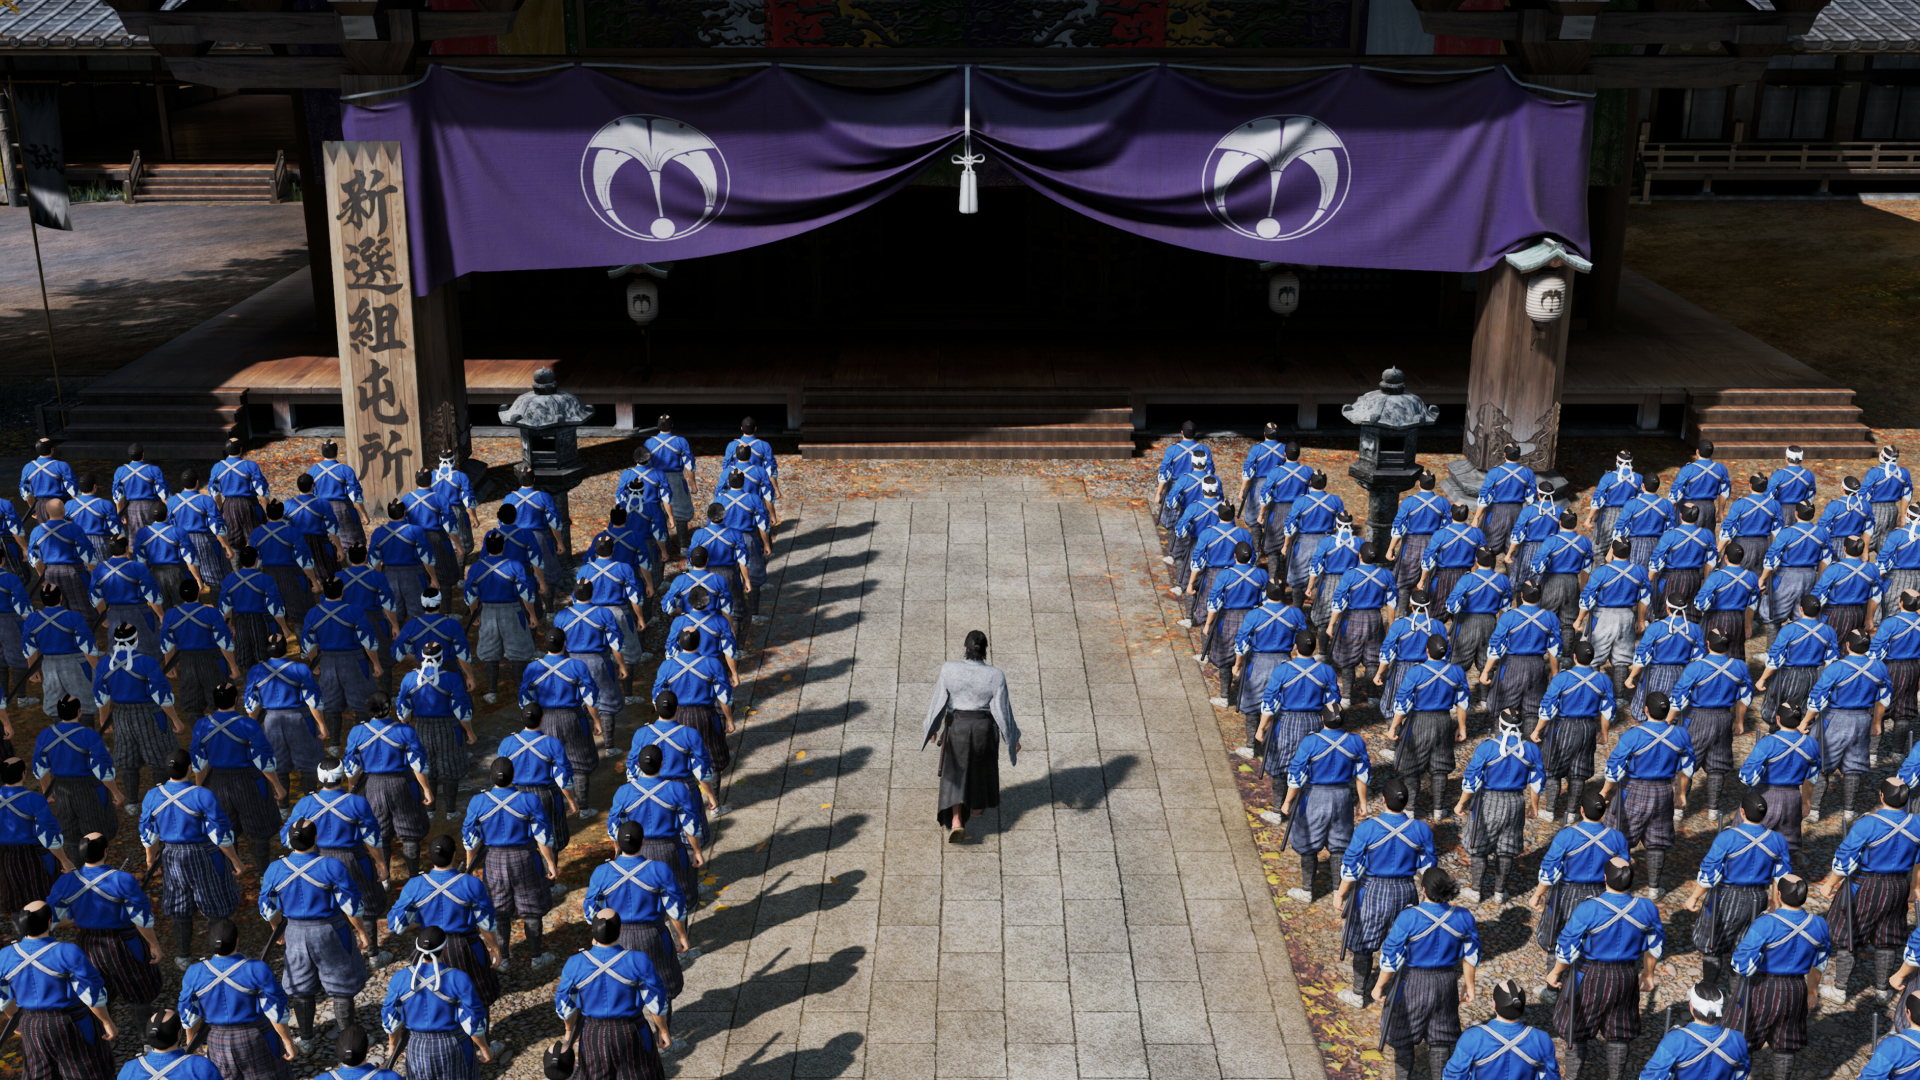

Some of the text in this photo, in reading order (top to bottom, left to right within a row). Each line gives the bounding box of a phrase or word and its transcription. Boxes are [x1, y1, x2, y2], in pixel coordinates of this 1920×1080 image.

[24, 143, 65, 175] 誠
[336, 169, 412, 494] 新選組屯所
